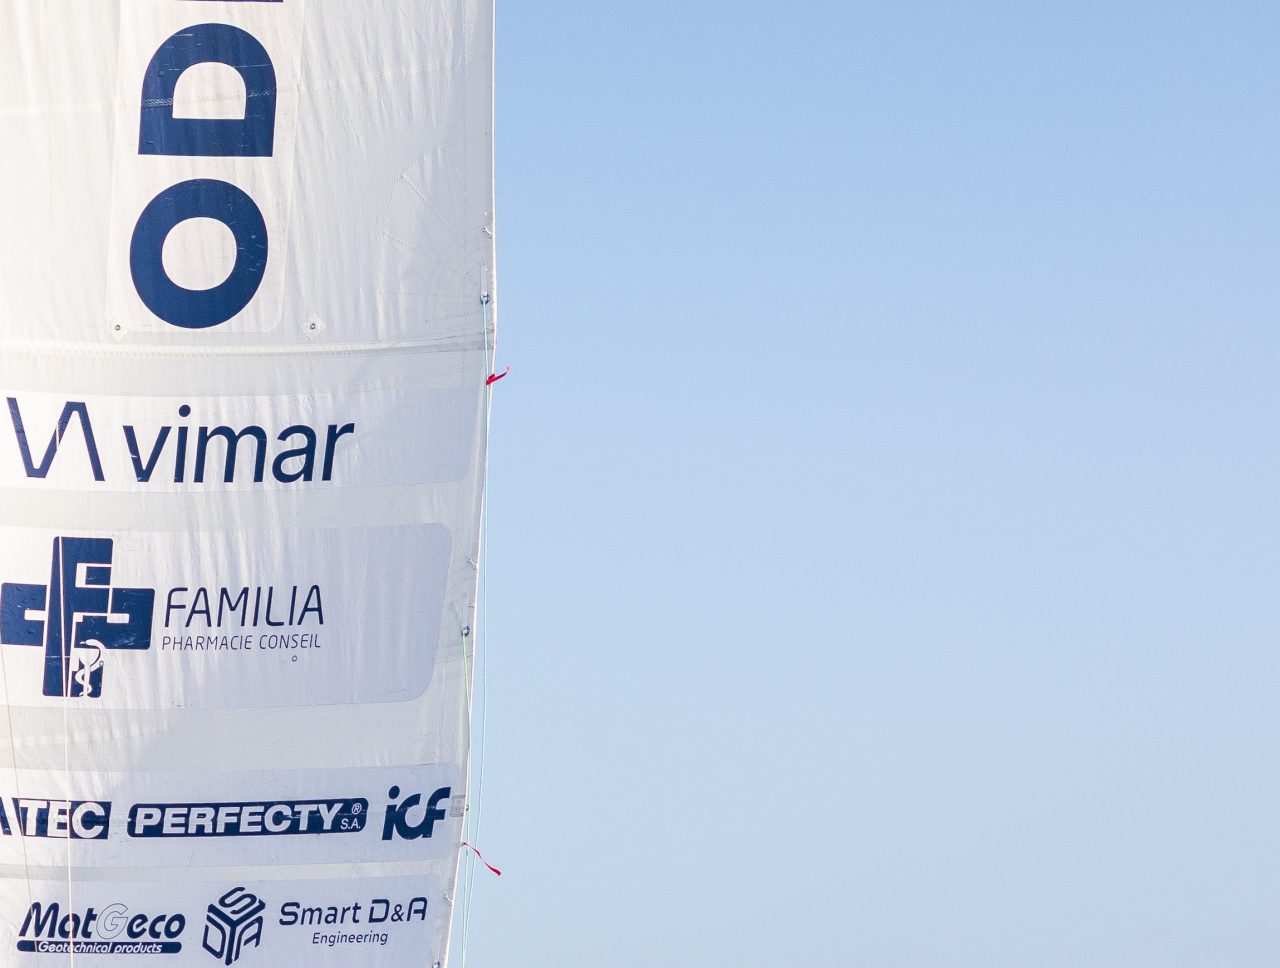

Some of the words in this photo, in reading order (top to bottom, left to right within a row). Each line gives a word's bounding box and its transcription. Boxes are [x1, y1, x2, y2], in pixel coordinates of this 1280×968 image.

[129, 0, 283, 329] OD
[122, 404, 354, 484] vimar
[164, 585, 325, 628] FAMILIA
[162, 635, 252, 651] PHARMACIE
[259, 634, 322, 650] CONSEIL
[134, 802, 344, 834] PERFECTY
[18, 901, 186, 940] MatGeco
[278, 901, 361, 926] Smart
[367, 896, 428, 924] D&A
[38, 940, 112, 954] Geotechnical
[112, 942, 162, 954] products
[312, 930, 388, 947] Engineering
